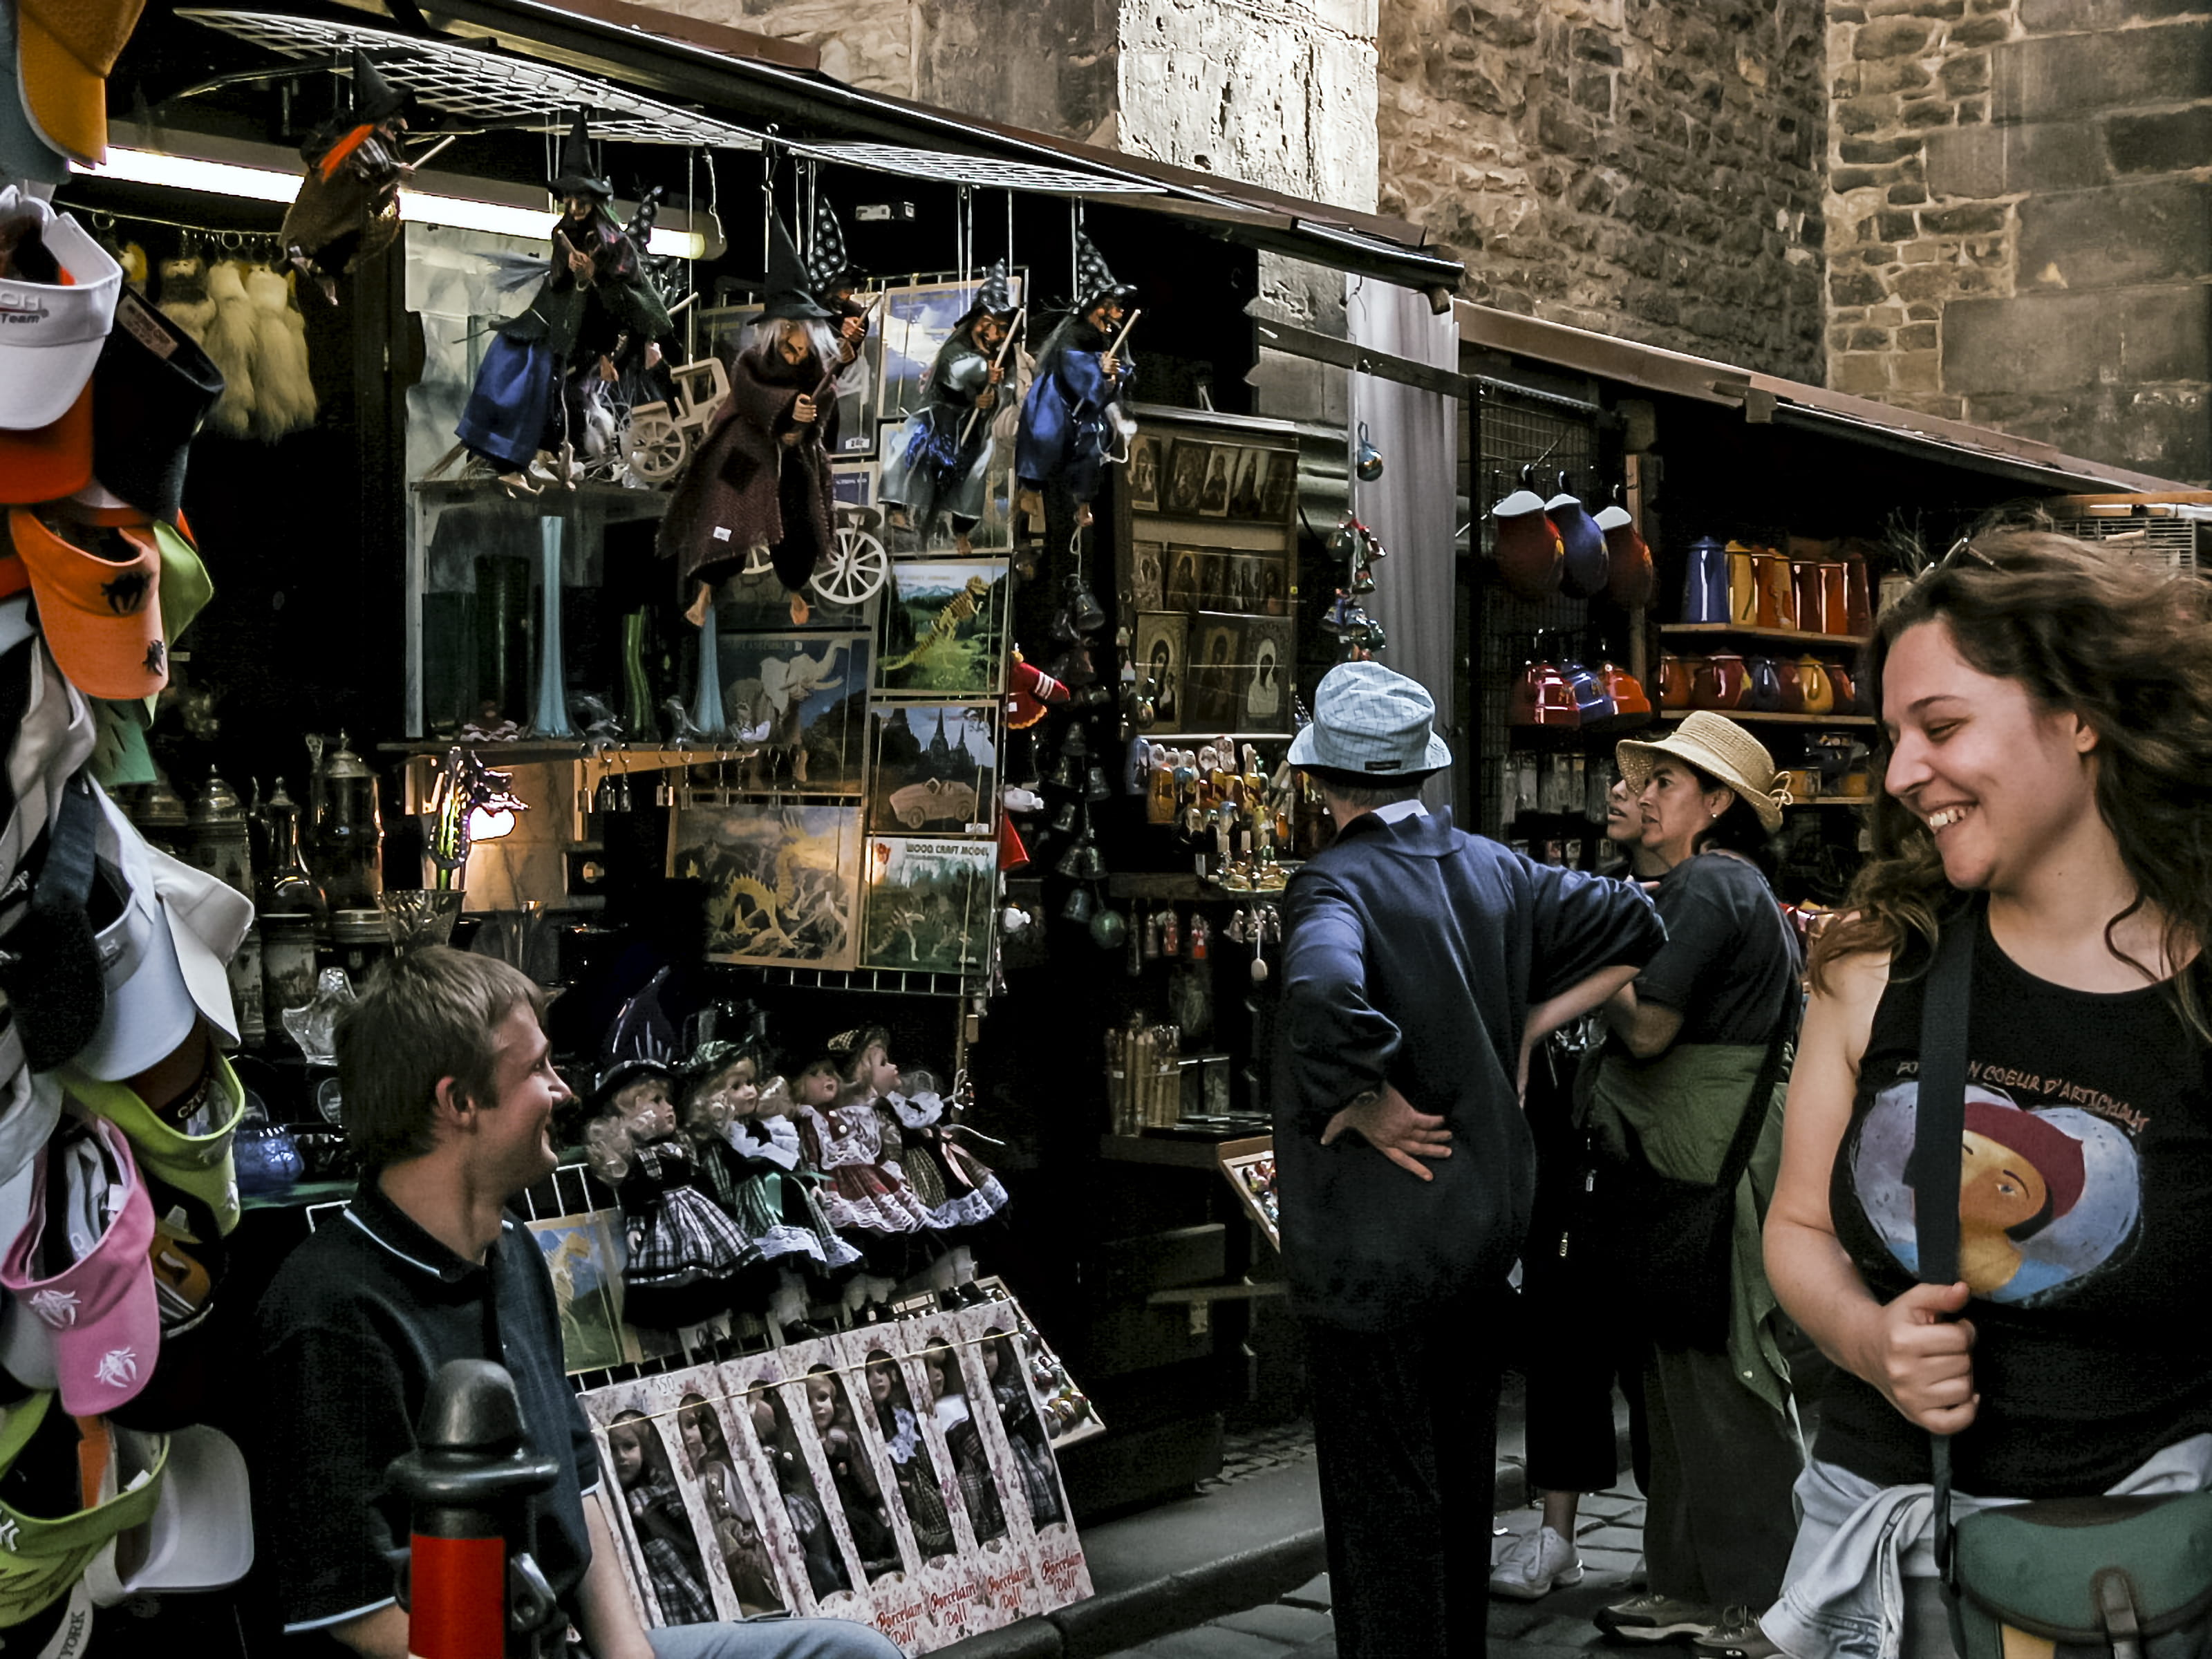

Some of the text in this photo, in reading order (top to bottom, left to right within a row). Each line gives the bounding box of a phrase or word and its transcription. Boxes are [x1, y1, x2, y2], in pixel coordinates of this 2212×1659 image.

[1, 313, 40, 324] Team
[906, 844, 989, 858] WOOD CRAFT MODEL
[1983, 1065, 2040, 1092] COEUR
[1054, 1569, 1076, 1593] Doll
[930, 1582, 977, 1613] Porcelain
[1001, 1585, 1022, 1609] Doll
[876, 1600, 924, 1632] Porcelain
[944, 1602, 967, 1627] Doll
[59, 1609, 86, 1657] YORK
[891, 1622, 917, 1646] Doll
